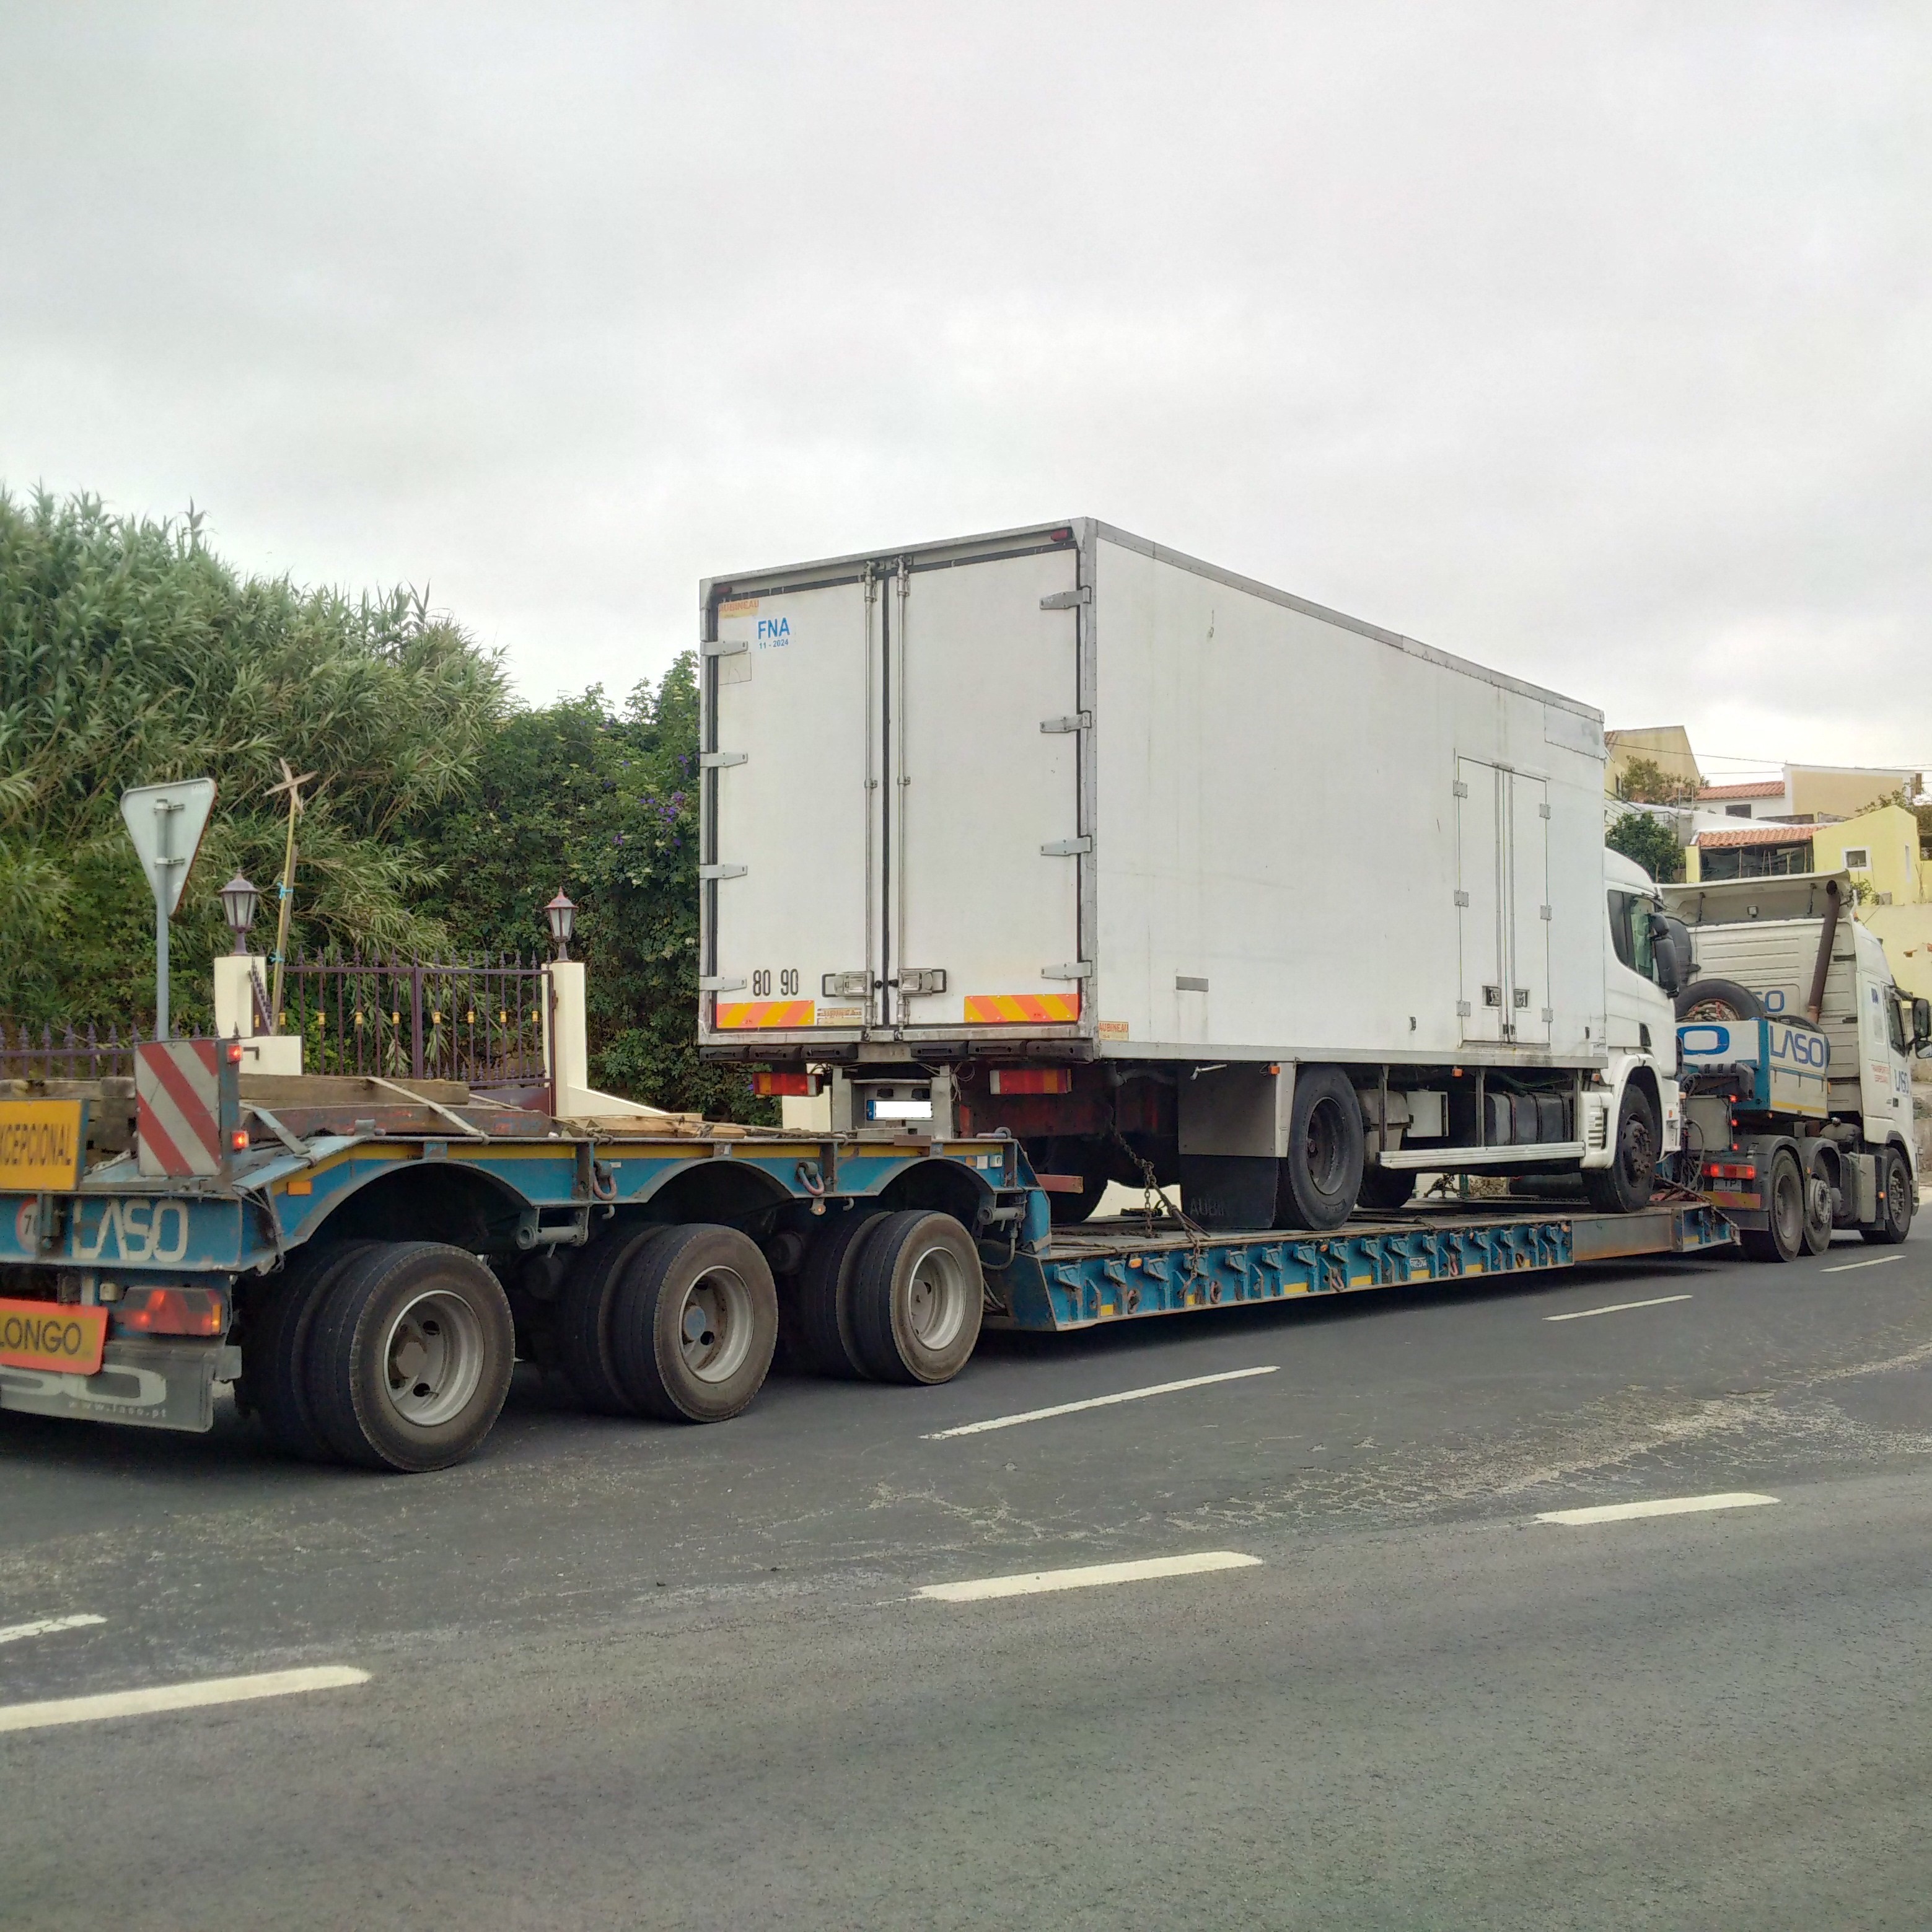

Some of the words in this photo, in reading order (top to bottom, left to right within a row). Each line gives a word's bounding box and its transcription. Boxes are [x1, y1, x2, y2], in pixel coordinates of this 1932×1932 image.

[758, 617, 790, 639] FNA
[759, 641, 766, 649] 11
[773, 638, 789, 648] 2024
[753, 969, 771, 996] 80
[780, 968, 798, 996] 90
[1770, 1025, 1824, 1068] LASO
[72, 1198, 189, 1263] LASO
[0, 1317, 82, 1355] ONGO
